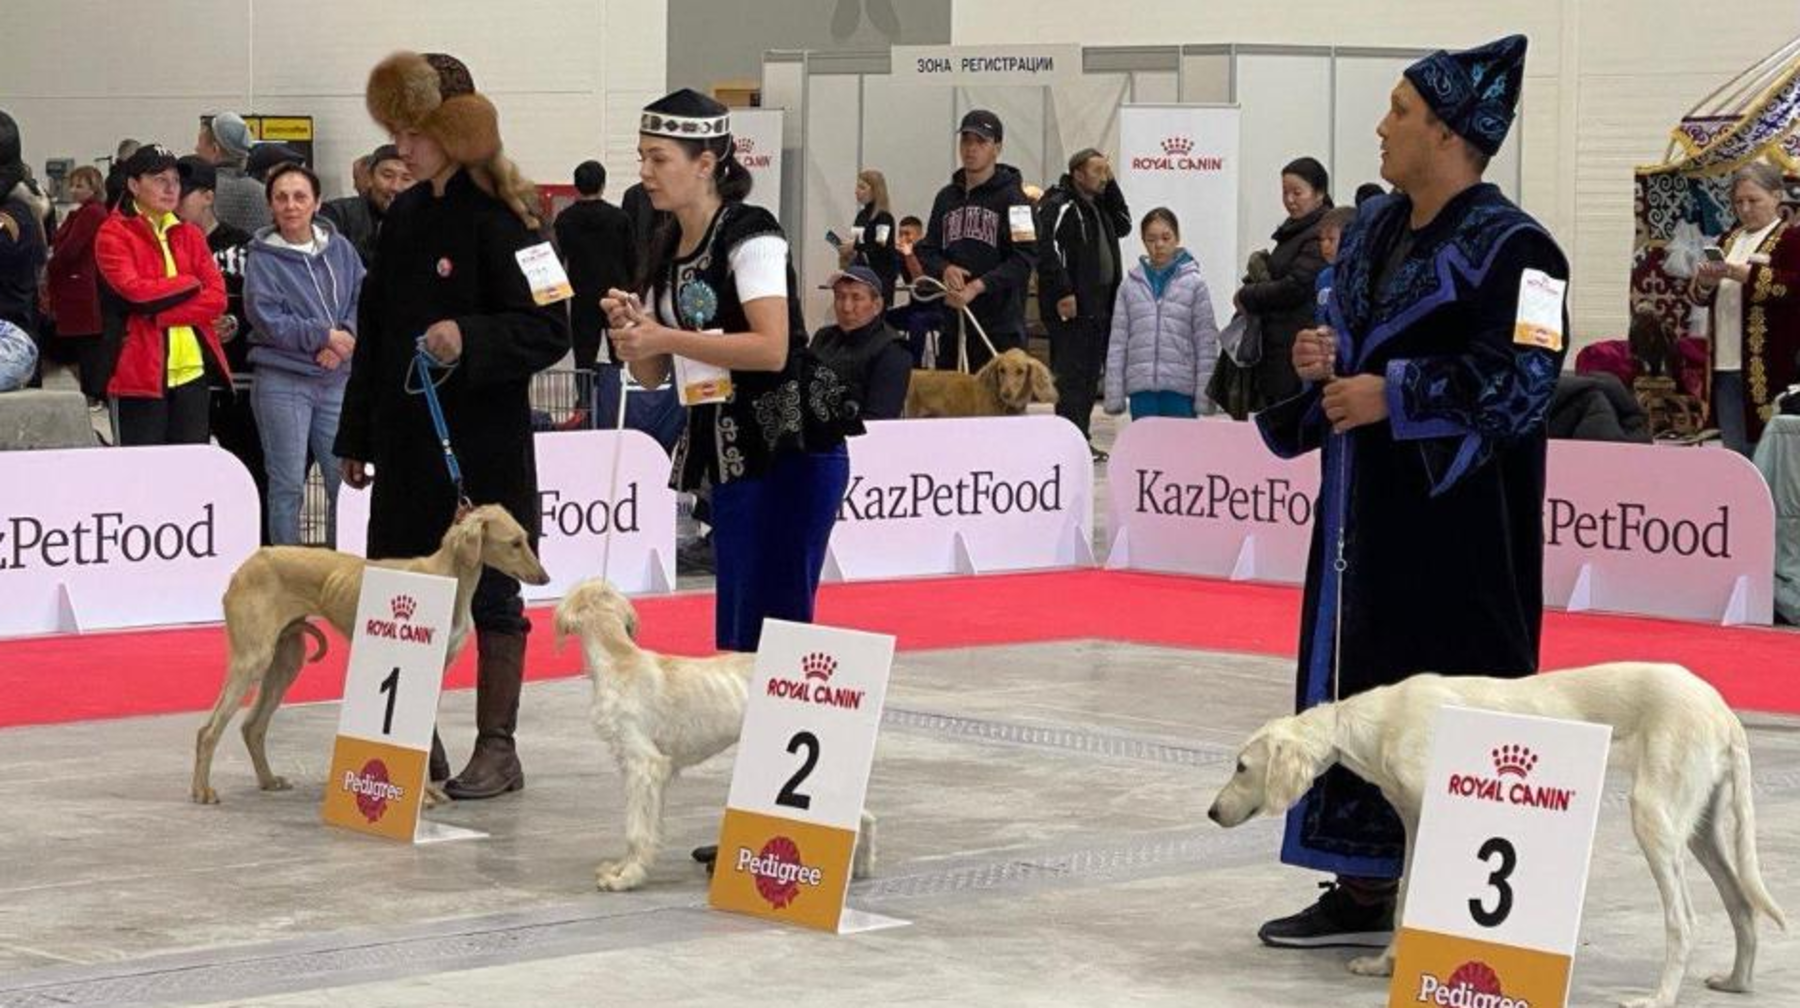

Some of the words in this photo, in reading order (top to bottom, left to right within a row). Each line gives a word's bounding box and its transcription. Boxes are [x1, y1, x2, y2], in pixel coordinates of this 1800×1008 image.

[917, 58, 952, 73] ЗОНА
[961, 57, 1054, 73] РЕГИСТРАЦИИ
[1132, 158, 1174, 170] ROYAL
[1178, 158, 1222, 170] CANIN
[837, 464, 1062, 521] KazPetFood
[366, 619, 398, 640] ROYAL
[400, 624, 433, 645] CANIN
[379, 667, 400, 735] 1
[767, 678, 810, 703] ROYAL
[814, 686, 862, 710] CANIN
[343, 770, 404, 801] Pedigree
[775, 731, 820, 810] 2
[1448, 774, 1505, 802] ROYAL
[1509, 783, 1571, 811] CANIN
[736, 847, 822, 886] Pedigree
[1468, 837, 1517, 928] 3
